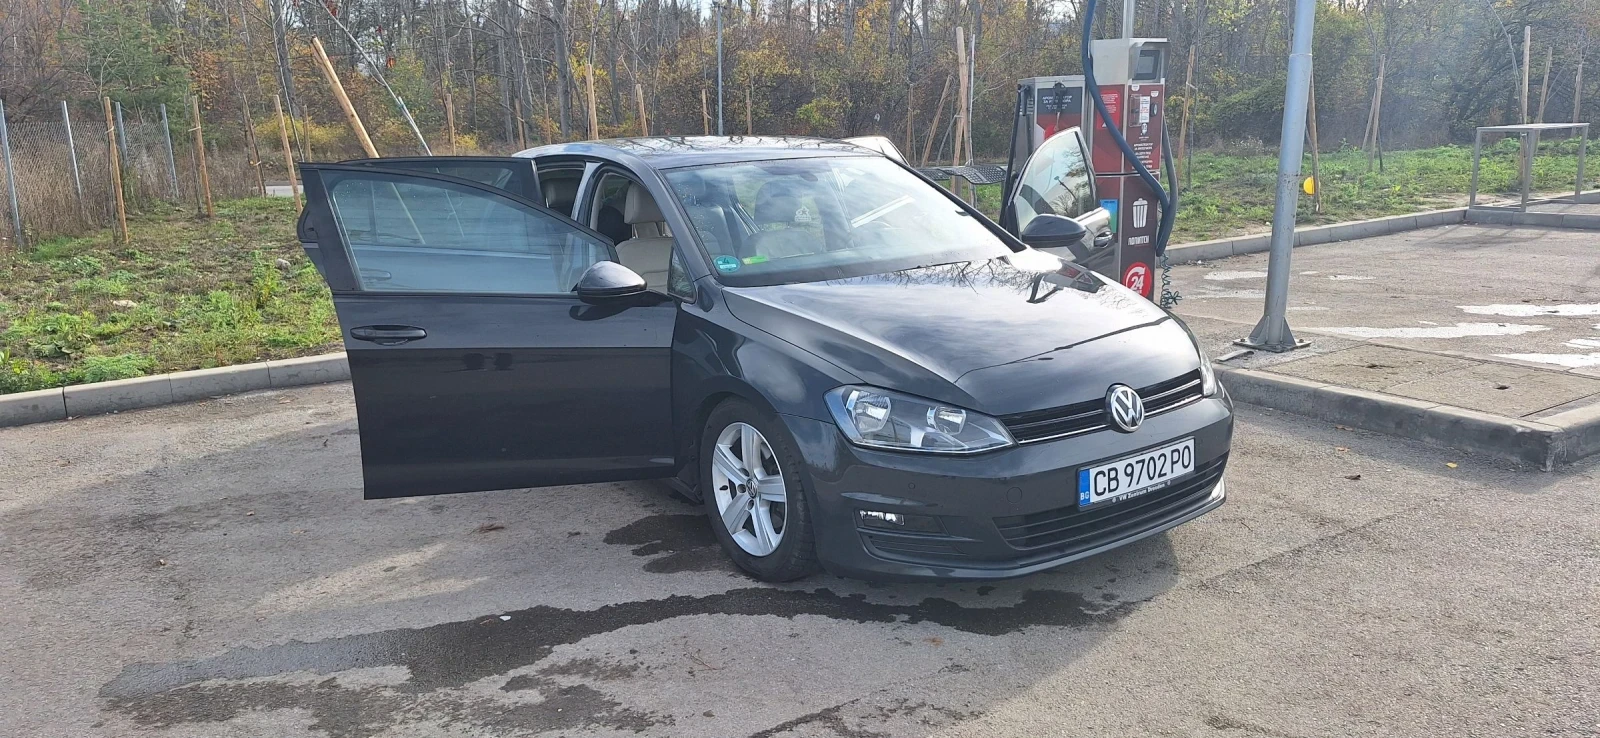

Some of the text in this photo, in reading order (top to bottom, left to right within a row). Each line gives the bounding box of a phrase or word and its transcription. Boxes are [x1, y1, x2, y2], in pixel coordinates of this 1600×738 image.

[1131, 275, 1145, 290] 24
[1094, 445, 1192, 496] CB 9702 PO
[1080, 491, 1090, 501] BG
[1127, 489, 1147, 499] Zentrum
[1147, 483, 1166, 493] Dresden
